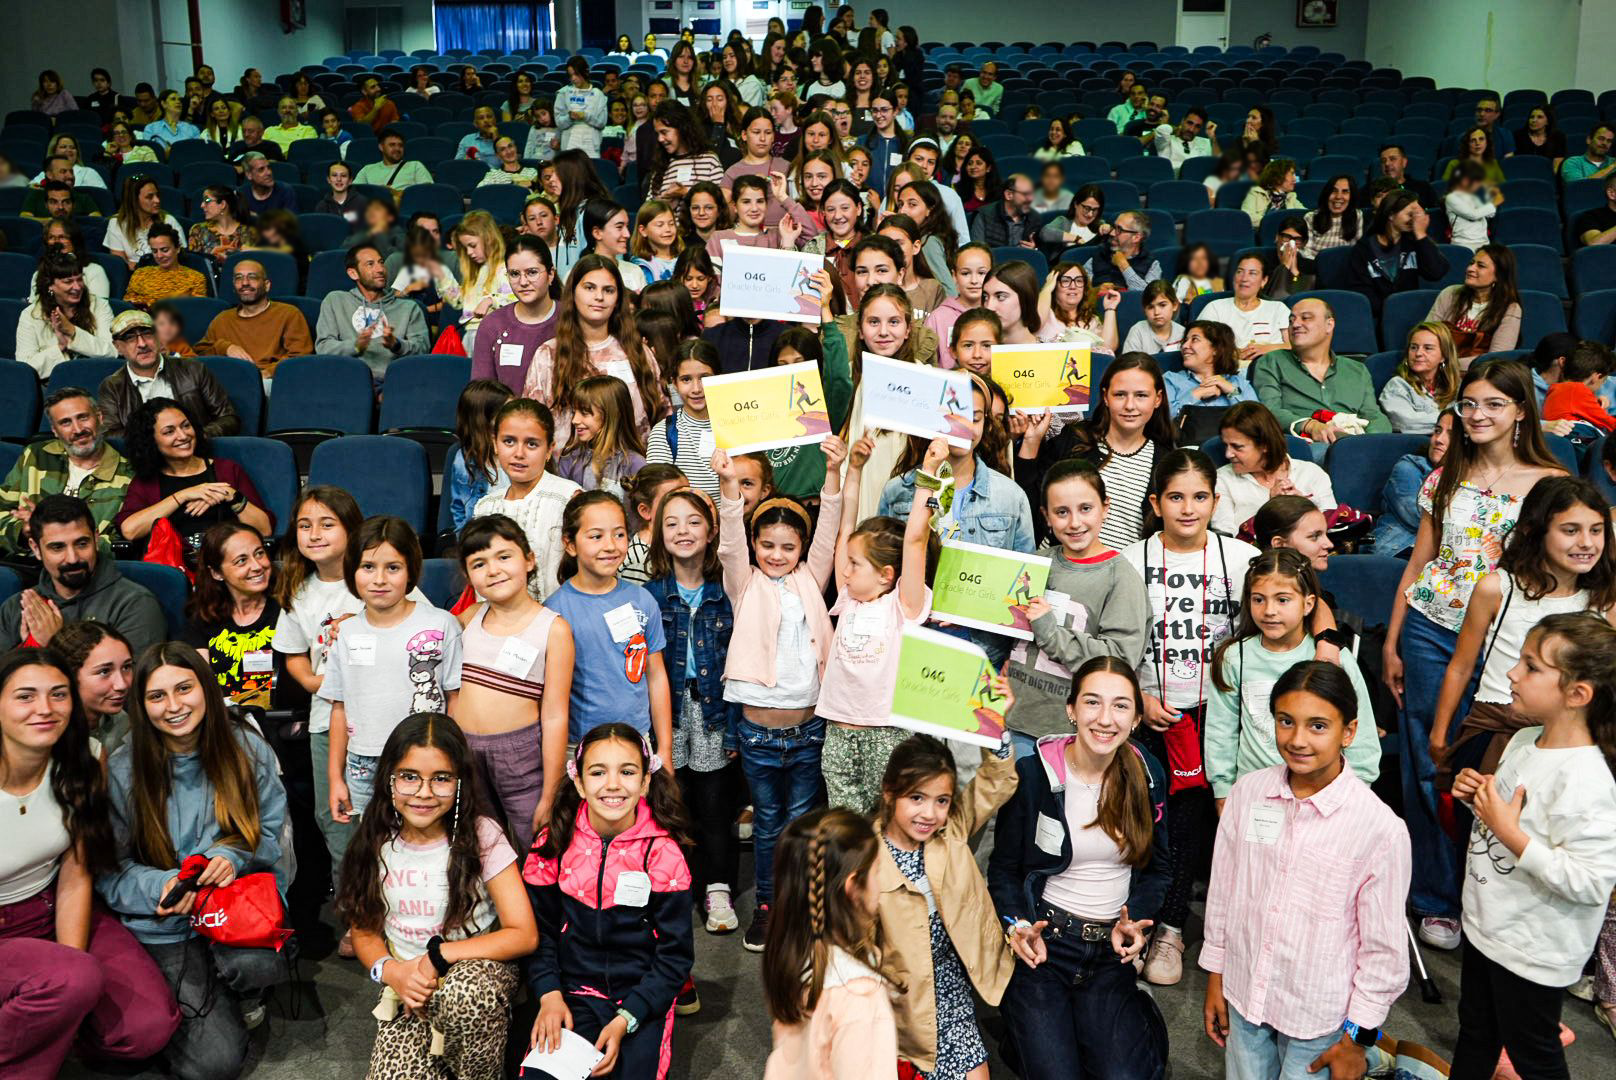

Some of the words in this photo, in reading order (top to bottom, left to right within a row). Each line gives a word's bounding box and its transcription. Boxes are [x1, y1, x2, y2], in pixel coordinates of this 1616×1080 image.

[744, 271, 766, 282] O4G
[727, 282, 750, 291] Oracle
[751, 283, 763, 292] for
[764, 285, 781, 294] Girls
[1013, 369, 1035, 379] O4G
[887, 382, 912, 395] O4G
[1022, 381, 1032, 389] for
[1035, 380, 1051, 389] Girls
[733, 400, 759, 412] O4G
[959, 571, 982, 585] O4G
[1145, 566, 1214, 590] How
[940, 582, 964, 594] Oracle
[965, 586, 977, 597] for
[978, 589, 997, 601] Girls
[1203, 598, 1242, 620] my
[921, 666, 946, 683] O4G
